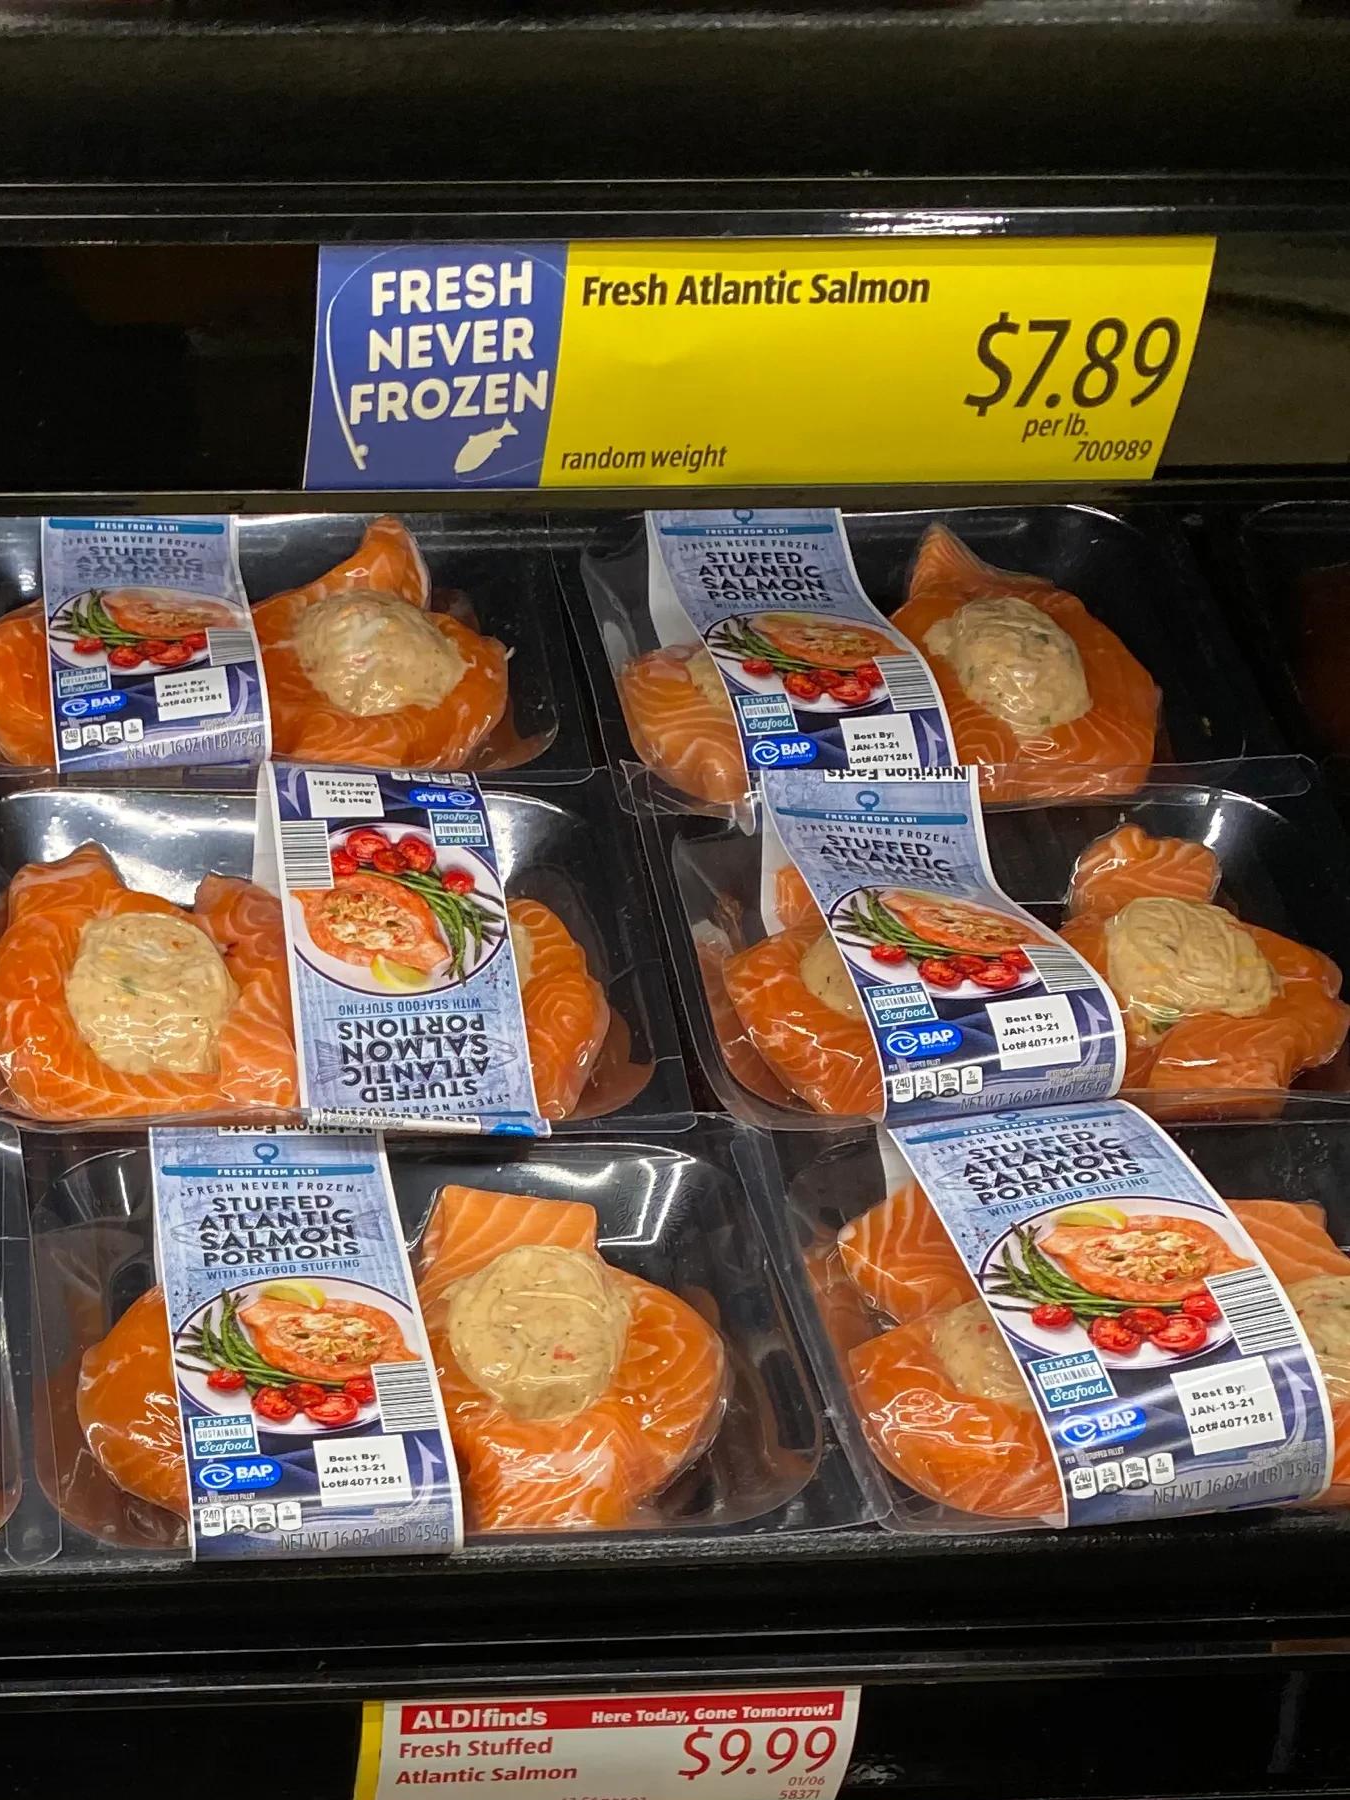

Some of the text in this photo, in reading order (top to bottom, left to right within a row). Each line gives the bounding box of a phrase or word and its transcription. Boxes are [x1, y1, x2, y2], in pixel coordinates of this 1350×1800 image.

[370, 260, 534, 316] FRESH
[582, 271, 930, 307] Fresh Atlantic Salmon
[367, 319, 535, 372] NEVER
[965, 312, 1181, 416] $7.89
[348, 370, 550, 424] FROZEN
[561, 443, 726, 473] random weight
[1074, 439, 1152, 463] 700989
[705, 552, 803, 564] STUFFED
[699, 565, 821, 578] ATLANTIC
[702, 577, 826, 591] SALMON
[708, 590, 833, 601] PORTIONS
[780, 742, 810, 755] BAP
[826, 834, 933, 856] STUFFED
[338, 1013, 484, 1039] PORTIONS
[918, 1029, 954, 1045] BAP
[343, 1034, 488, 1065] SALMON
[342, 1057, 490, 1085] ATLANTIC
[968, 1131, 1097, 1160] STUFFED
[963, 1137, 1123, 1177] ATLANTIC
[217, 1168, 319, 1177] FRESH FROM ALDI
[967, 1149, 1135, 1190] SALMON
[242, 1182, 290, 1192] NEVER
[297, 1183, 355, 1193] FROZEN
[975, 1162, 1145, 1205] PORTIONS
[212, 1195, 333, 1213] STUFFED
[988, 1176, 1150, 1218] WITH SEAFOOD STUFFING
[198, 1208, 353, 1232] ATLANTIC
[200, 1225, 356, 1251] SALMON
[204, 1241, 362, 1268] PORTIONS
[206, 1260, 360, 1280] WITH SEAFOOD STUFFING
[1190, 1397, 1255, 1417] JAN-13-21
[1097, 1412, 1137, 1431] BAP
[1190, 1412, 1274, 1436] Lot#4071281
[323, 1463, 386, 1475] JAN-13-21
[329, 1455, 358, 1463] Best
[236, 1464, 274, 1479] BAP
[321, 1475, 403, 1489] Lot#4071281
[591, 1711, 633, 1724] Here
[637, 1709, 689, 1724] Today,
[694, 1707, 737, 1722] Gone
[742, 1704, 834, 1720] Tomorrow!
[399, 1737, 553, 1759] Fresh Stuffed
[678, 1726, 837, 1781] $9.99
[396, 1764, 578, 1785] Atlantic Salmon
[788, 1776, 825, 1787] 01/06
[779, 1789, 821, 1800] 58371
